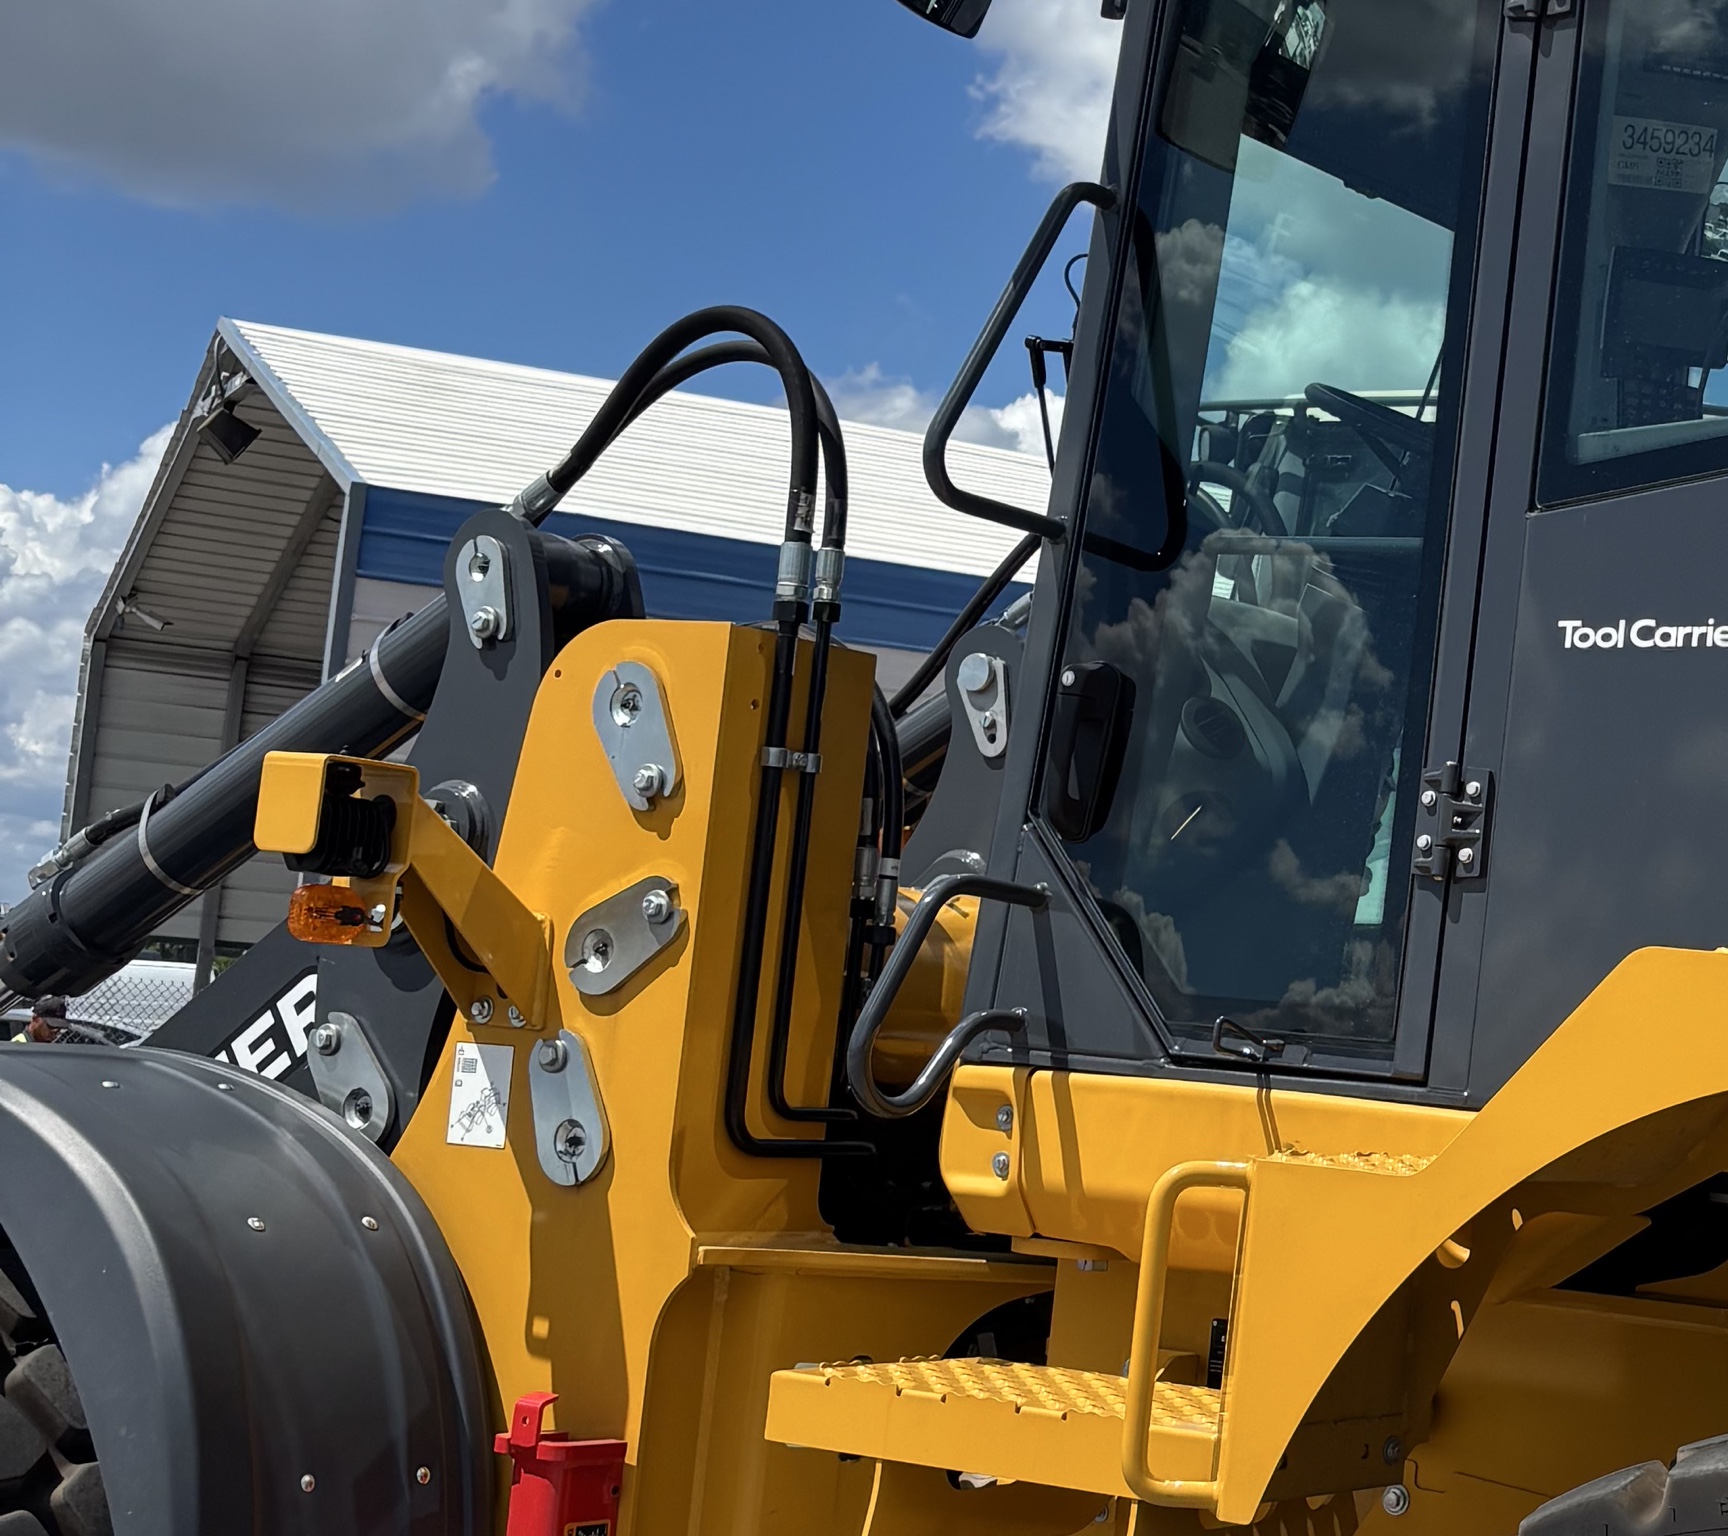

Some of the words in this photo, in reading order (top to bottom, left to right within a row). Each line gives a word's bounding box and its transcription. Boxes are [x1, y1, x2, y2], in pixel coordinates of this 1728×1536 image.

[1622, 123, 1716, 158] 3459234
[1557, 619, 1626, 649] Tool
[214, 973, 318, 1080] ER
